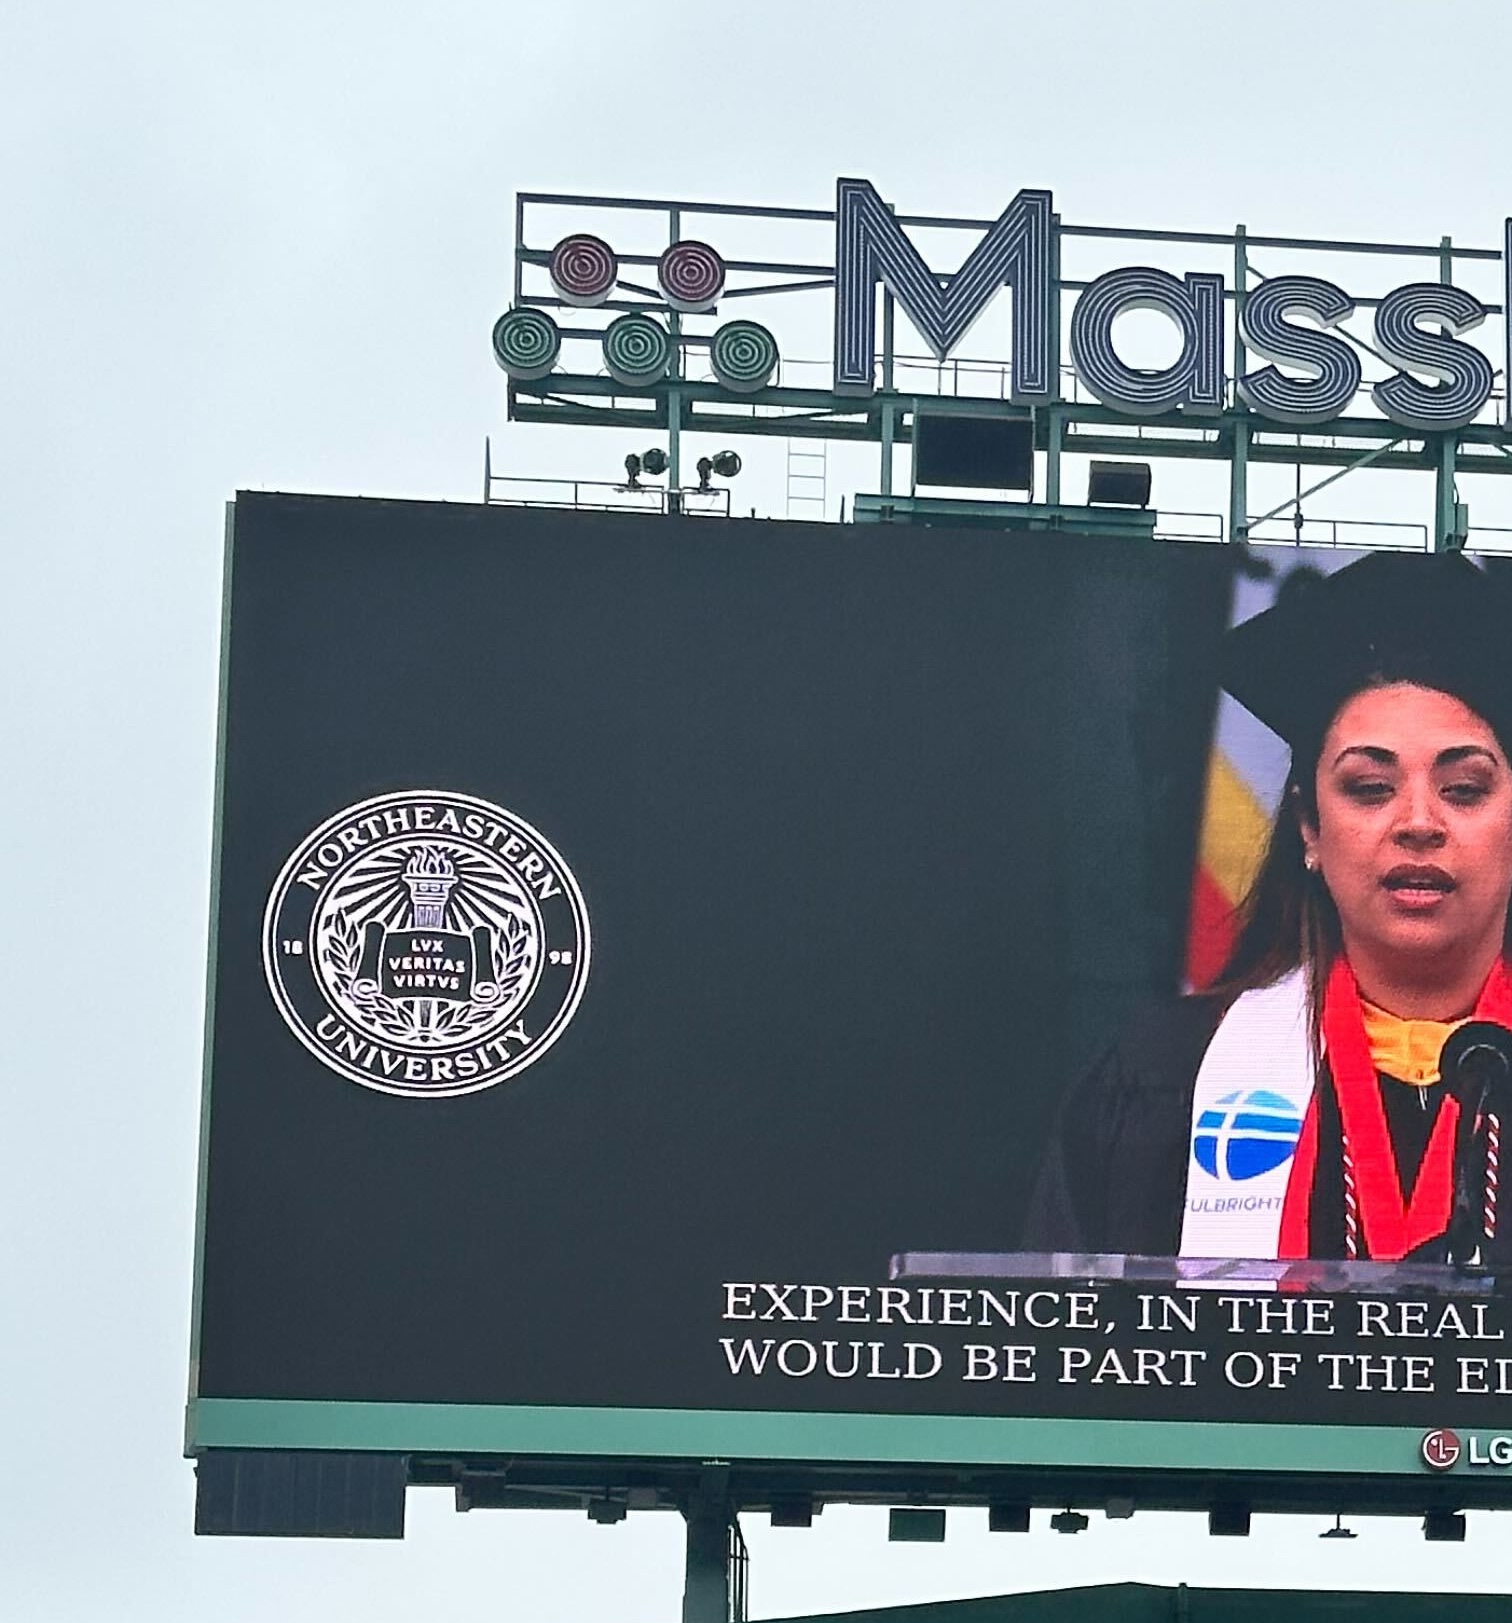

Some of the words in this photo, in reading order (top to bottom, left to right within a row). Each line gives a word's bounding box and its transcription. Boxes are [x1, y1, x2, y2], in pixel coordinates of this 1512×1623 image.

[297, 807, 562, 900] NORTHEASTERN
[411, 939, 444, 953] LVX
[389, 956, 466, 974] VERITAS
[393, 973, 460, 991] VIRTVS
[315, 1013, 532, 1081] UNIVERSITY
[1185, 1196, 1282, 1213] ULBRIGHT
[721, 1283, 1117, 1335] EXPERIENCE,
[1136, 1294, 1201, 1332] IN
[1217, 1296, 1335, 1336] THE
[1356, 1302, 1505, 1340] REAL
[718, 1338, 943, 1380] WOULD
[962, 1345, 1037, 1383] BE
[1058, 1347, 1207, 1387] PART
[1224, 1351, 1303, 1389] OF
[1318, 1354, 1435, 1393] THE
